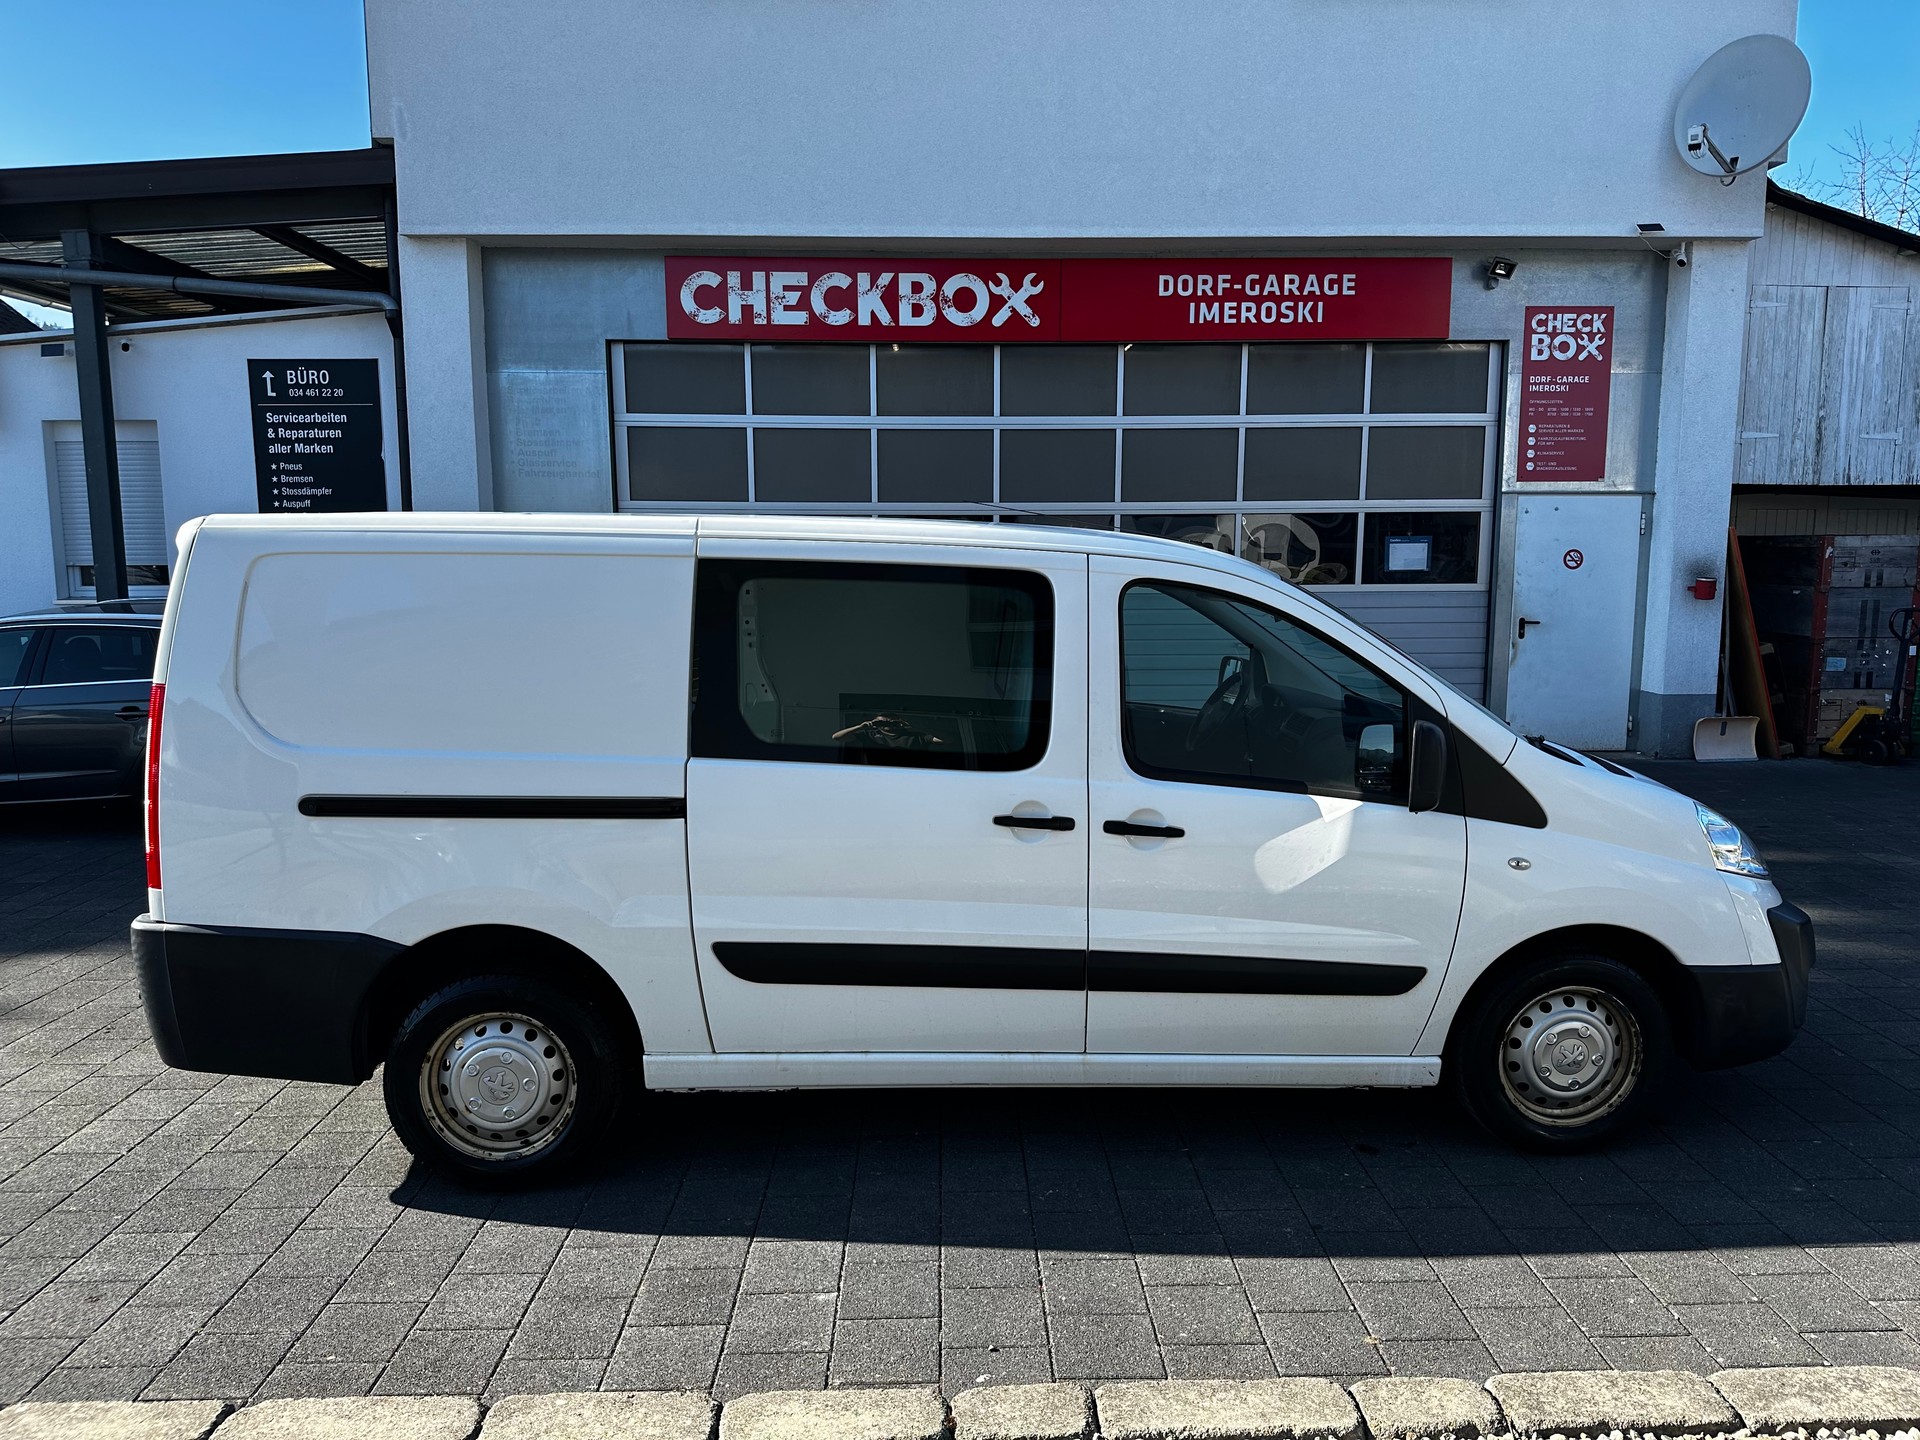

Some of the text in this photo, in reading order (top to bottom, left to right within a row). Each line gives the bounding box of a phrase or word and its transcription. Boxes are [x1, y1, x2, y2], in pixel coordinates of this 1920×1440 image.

[1158, 274, 1356, 296] DORF-GARAGE
[680, 271, 1044, 327] CHECKBOX
[1189, 302, 1324, 324] IMEROSKI
[1531, 313, 1608, 333] CHECK
[1530, 334, 1606, 362] BOX
[286, 366, 330, 384] BÜRO
[1529, 376, 1590, 384] DORF-GARAGE
[288, 388, 344, 397] 034 461 22 20
[266, 412, 347, 423] Servicearbeiten
[268, 428, 342, 440] & Reparaturen
[268, 443, 334, 454] aller Marken
[280, 462, 303, 471] Pneus
[281, 487, 332, 497] Stossdämpfer
[282, 500, 311, 509] Auspuff
